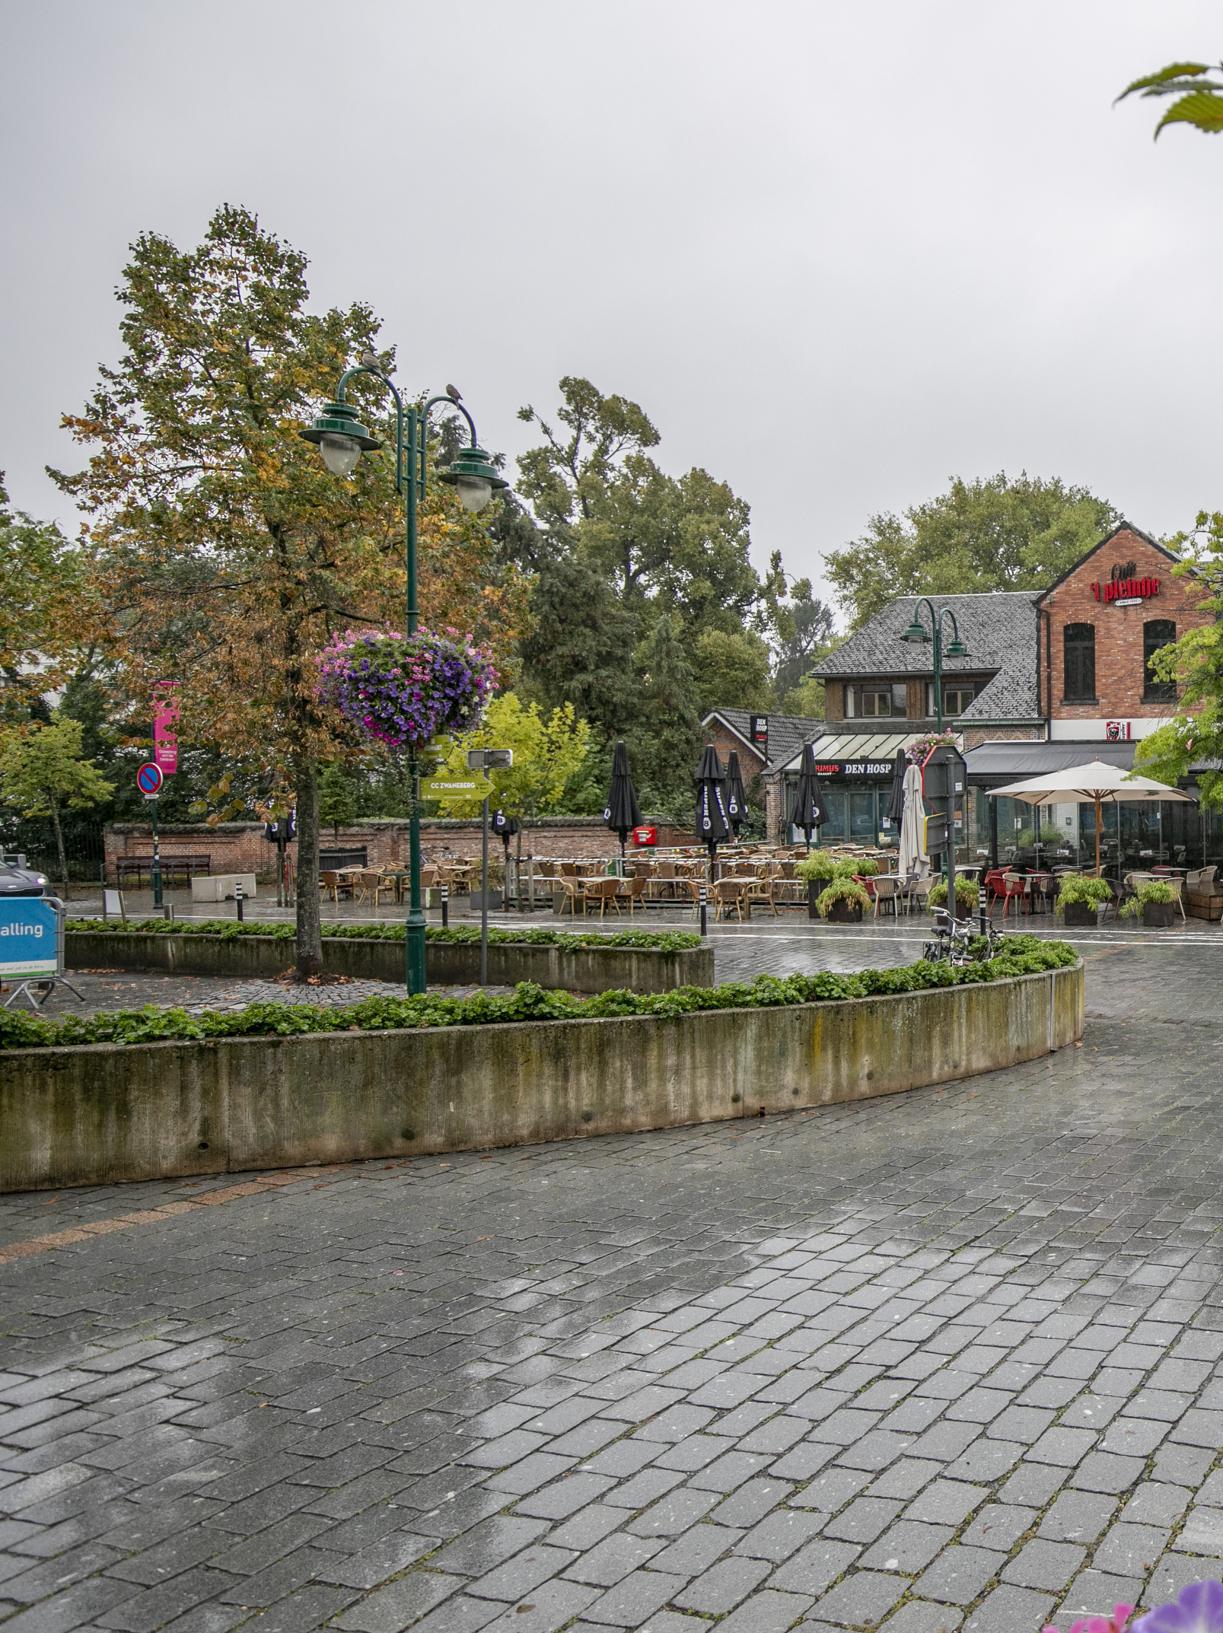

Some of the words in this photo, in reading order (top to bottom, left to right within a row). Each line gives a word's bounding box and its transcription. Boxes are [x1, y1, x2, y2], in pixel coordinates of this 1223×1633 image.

[815, 764, 839, 772] RIMUS
[844, 764, 865, 774] DEN
[866, 763, 892, 773] HOSP
[0, 922, 43, 938] alling
